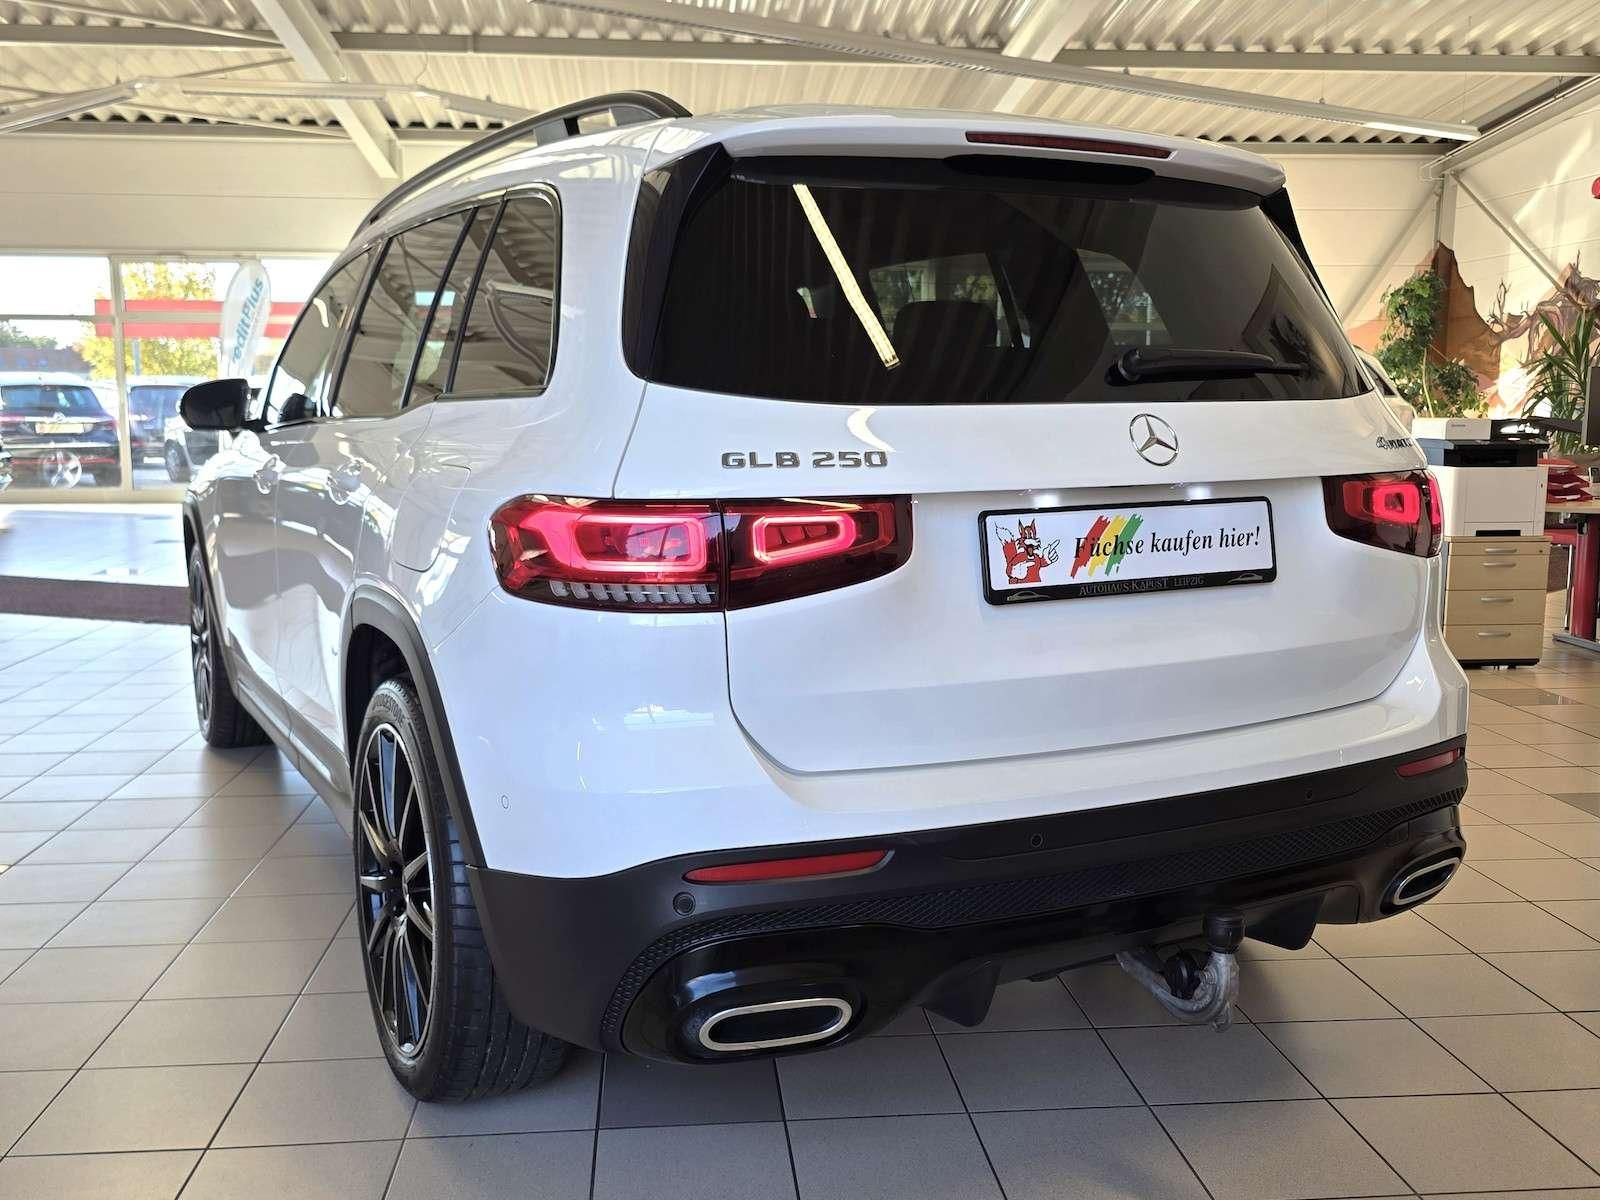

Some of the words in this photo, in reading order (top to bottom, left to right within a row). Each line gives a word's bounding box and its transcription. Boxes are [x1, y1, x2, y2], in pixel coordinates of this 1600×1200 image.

[721, 451, 801, 469] GLB
[812, 451, 888, 468] 250
[1073, 534, 1145, 559] Füchse
[1151, 529, 1214, 557] kaufen
[1218, 526, 1260, 549] hier!
[1080, 582, 1130, 597] AUTOHAUS
[1174, 574, 1206, 588] LEIPZIG
